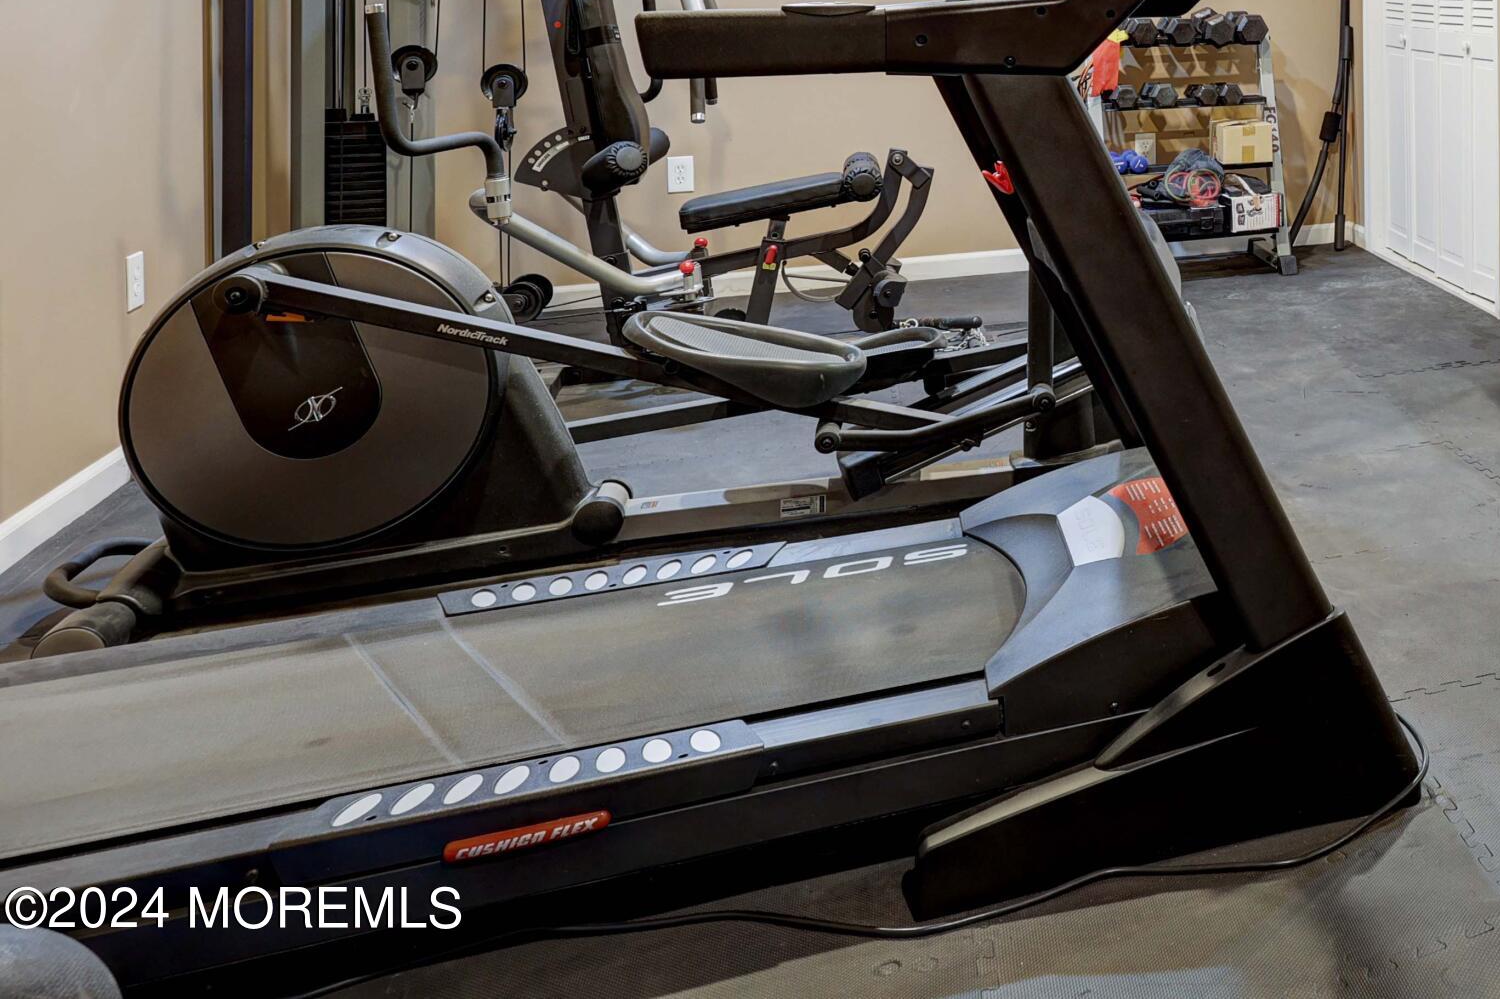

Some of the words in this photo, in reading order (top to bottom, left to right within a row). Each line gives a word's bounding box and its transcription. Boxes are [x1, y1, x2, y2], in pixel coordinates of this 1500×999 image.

[437, 323, 509, 346] NordicTrack
[656, 543, 968, 607] SOLE
[455, 830, 546, 860] CUSHION
[550, 816, 599, 840] FLEX
